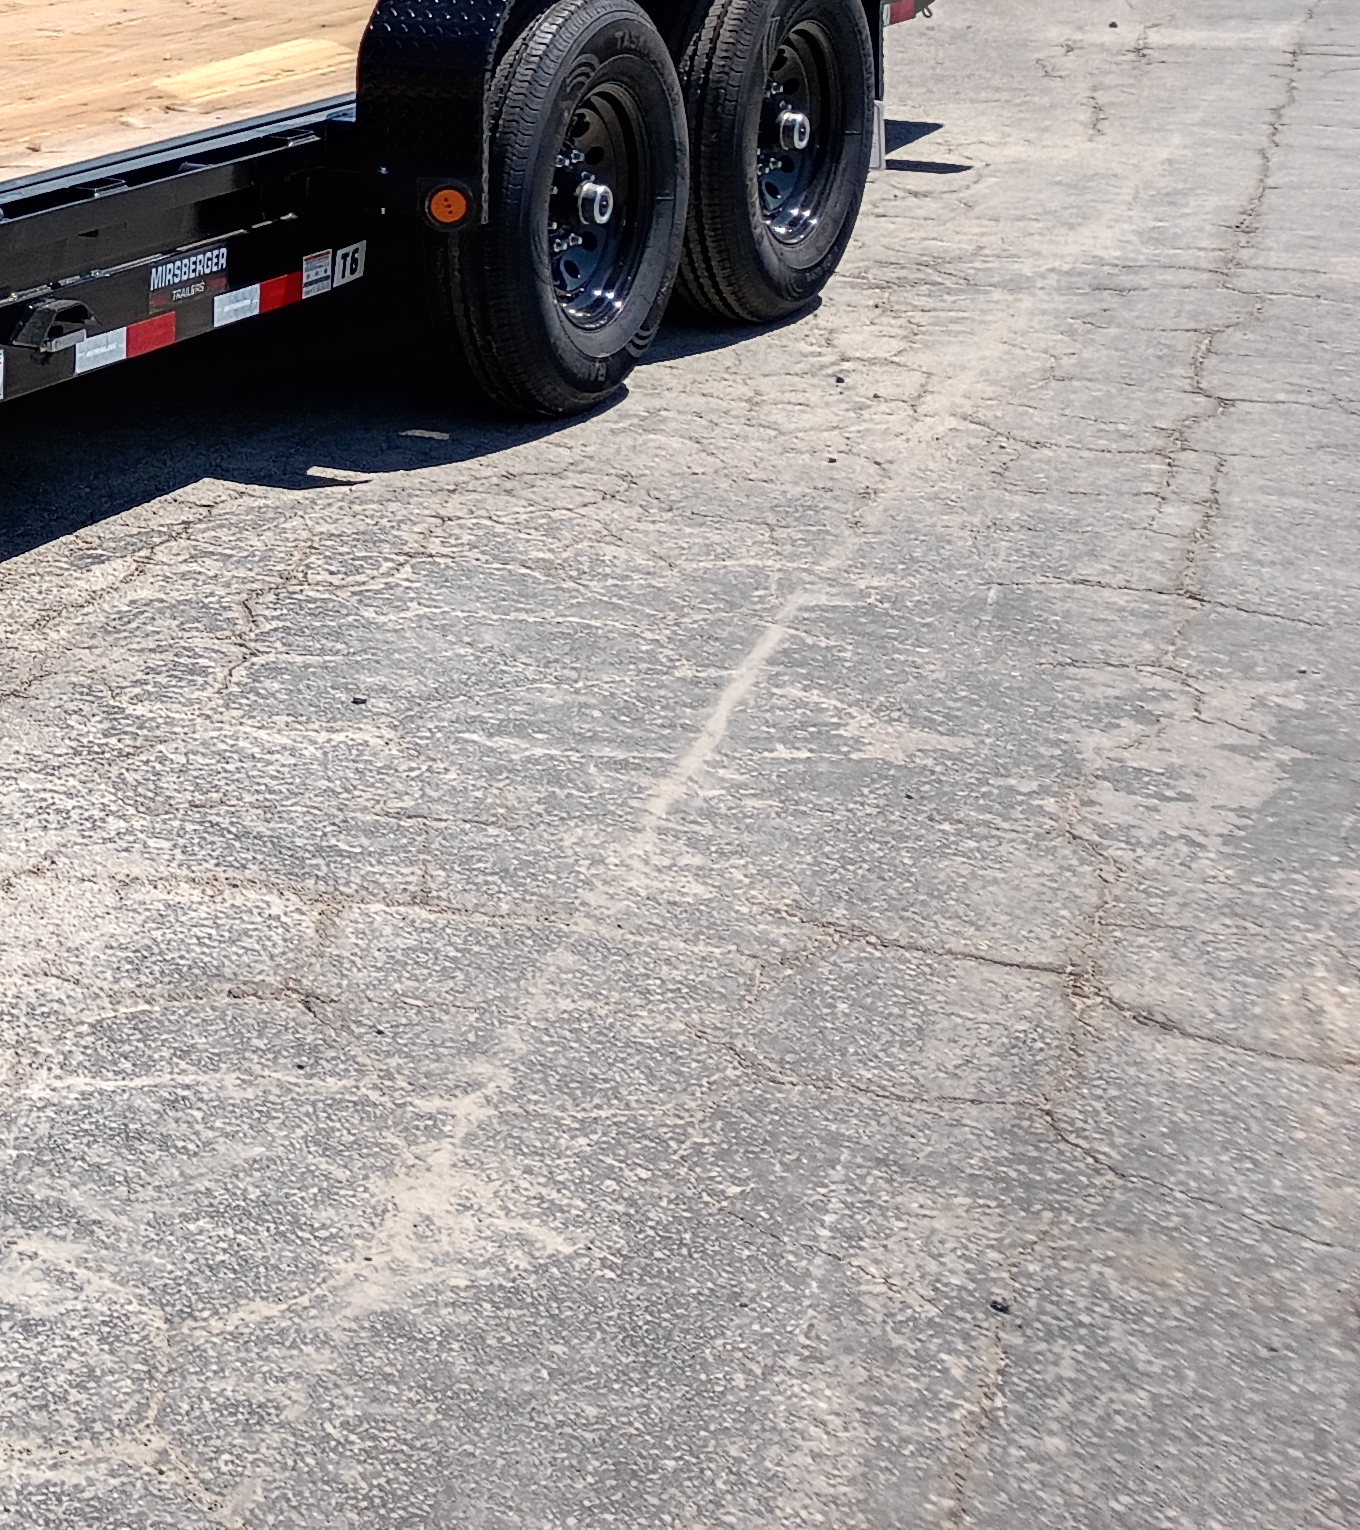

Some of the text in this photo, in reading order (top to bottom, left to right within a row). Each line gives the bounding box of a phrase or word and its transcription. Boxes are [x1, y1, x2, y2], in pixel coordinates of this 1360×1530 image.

[150, 247, 227, 291] MIRSBERGER
[341, 247, 360, 279] T6
[172, 281, 206, 302] TRAILERS
